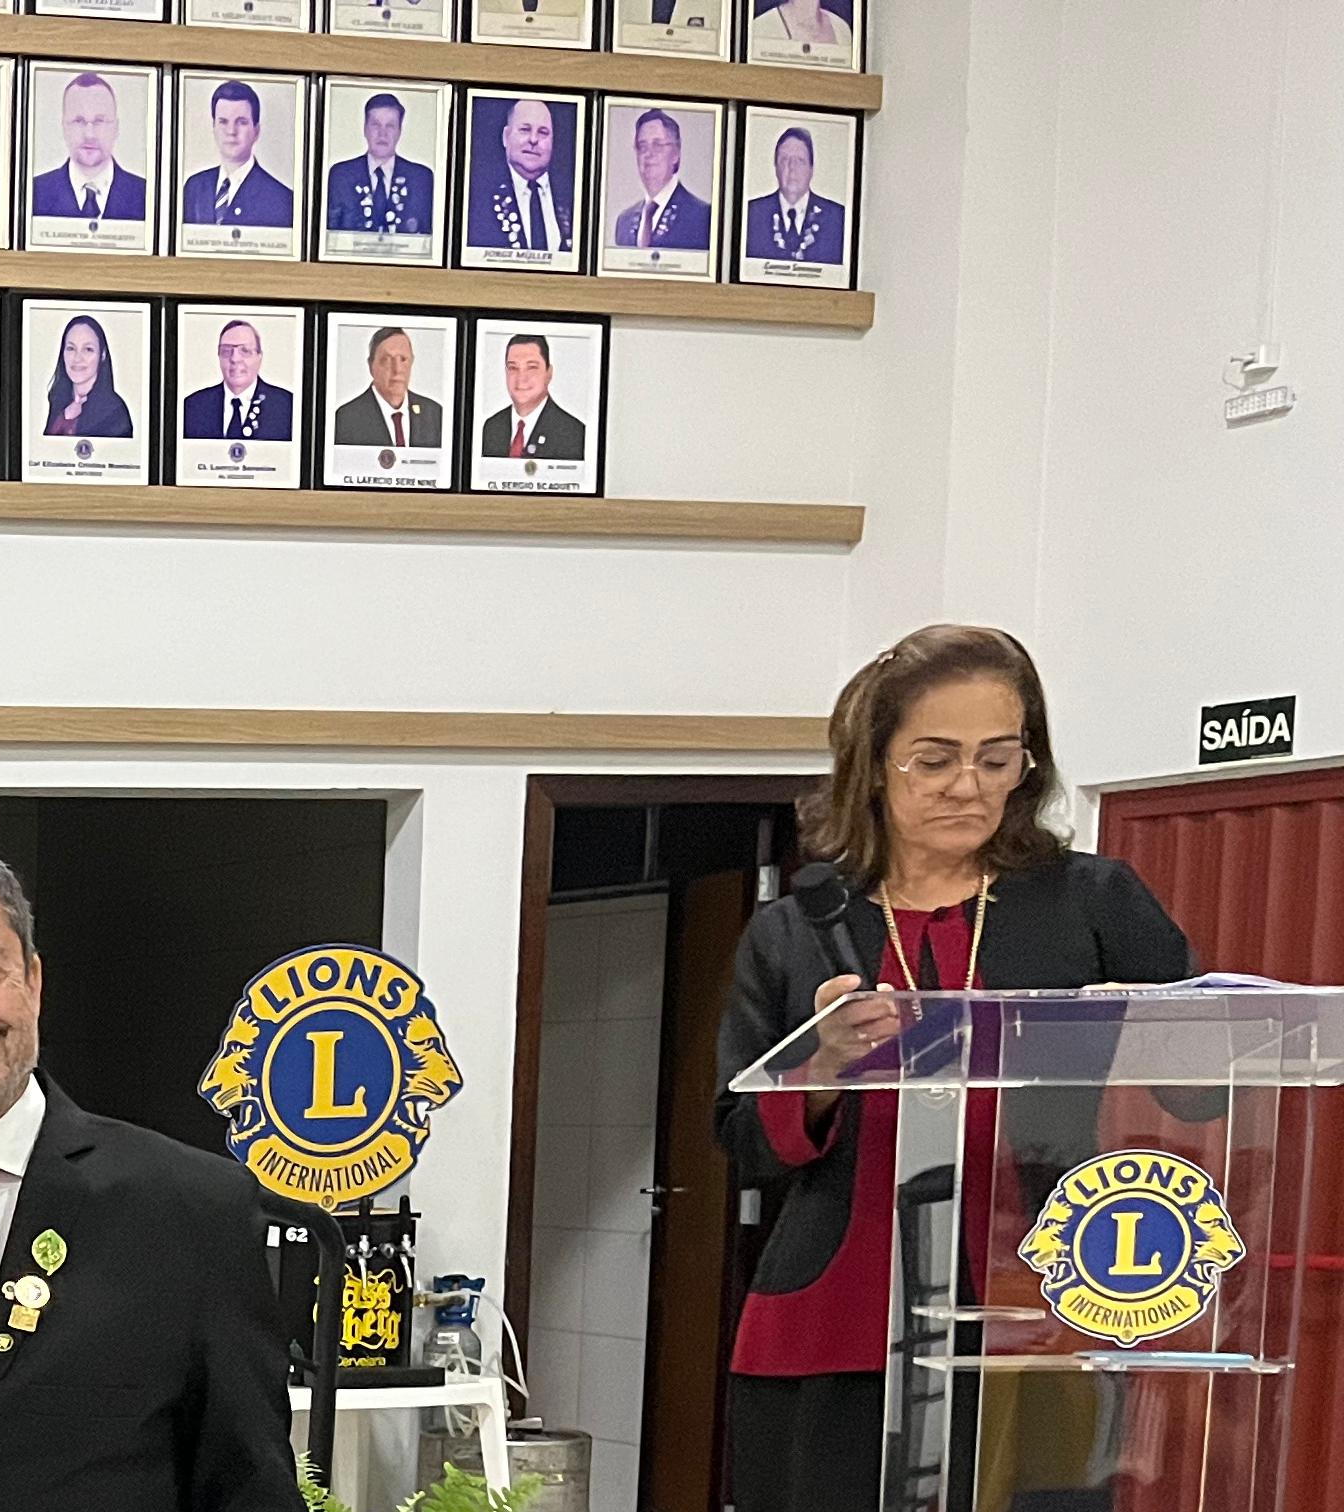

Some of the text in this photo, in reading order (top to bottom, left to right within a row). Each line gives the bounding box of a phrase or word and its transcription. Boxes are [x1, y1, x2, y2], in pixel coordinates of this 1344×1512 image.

[1201, 708, 1291, 751] SAÍDA
[259, 956, 410, 1014] LIONS
[303, 1031, 368, 1119] L
[257, 1145, 402, 1192] INTERNATIONAL
[1074, 1160, 1199, 1200] LIONS
[285, 1227, 309, 1244] 62
[1108, 1212, 1163, 1275] L
[1067, 1295, 1192, 1328] INTERNATIONAL
